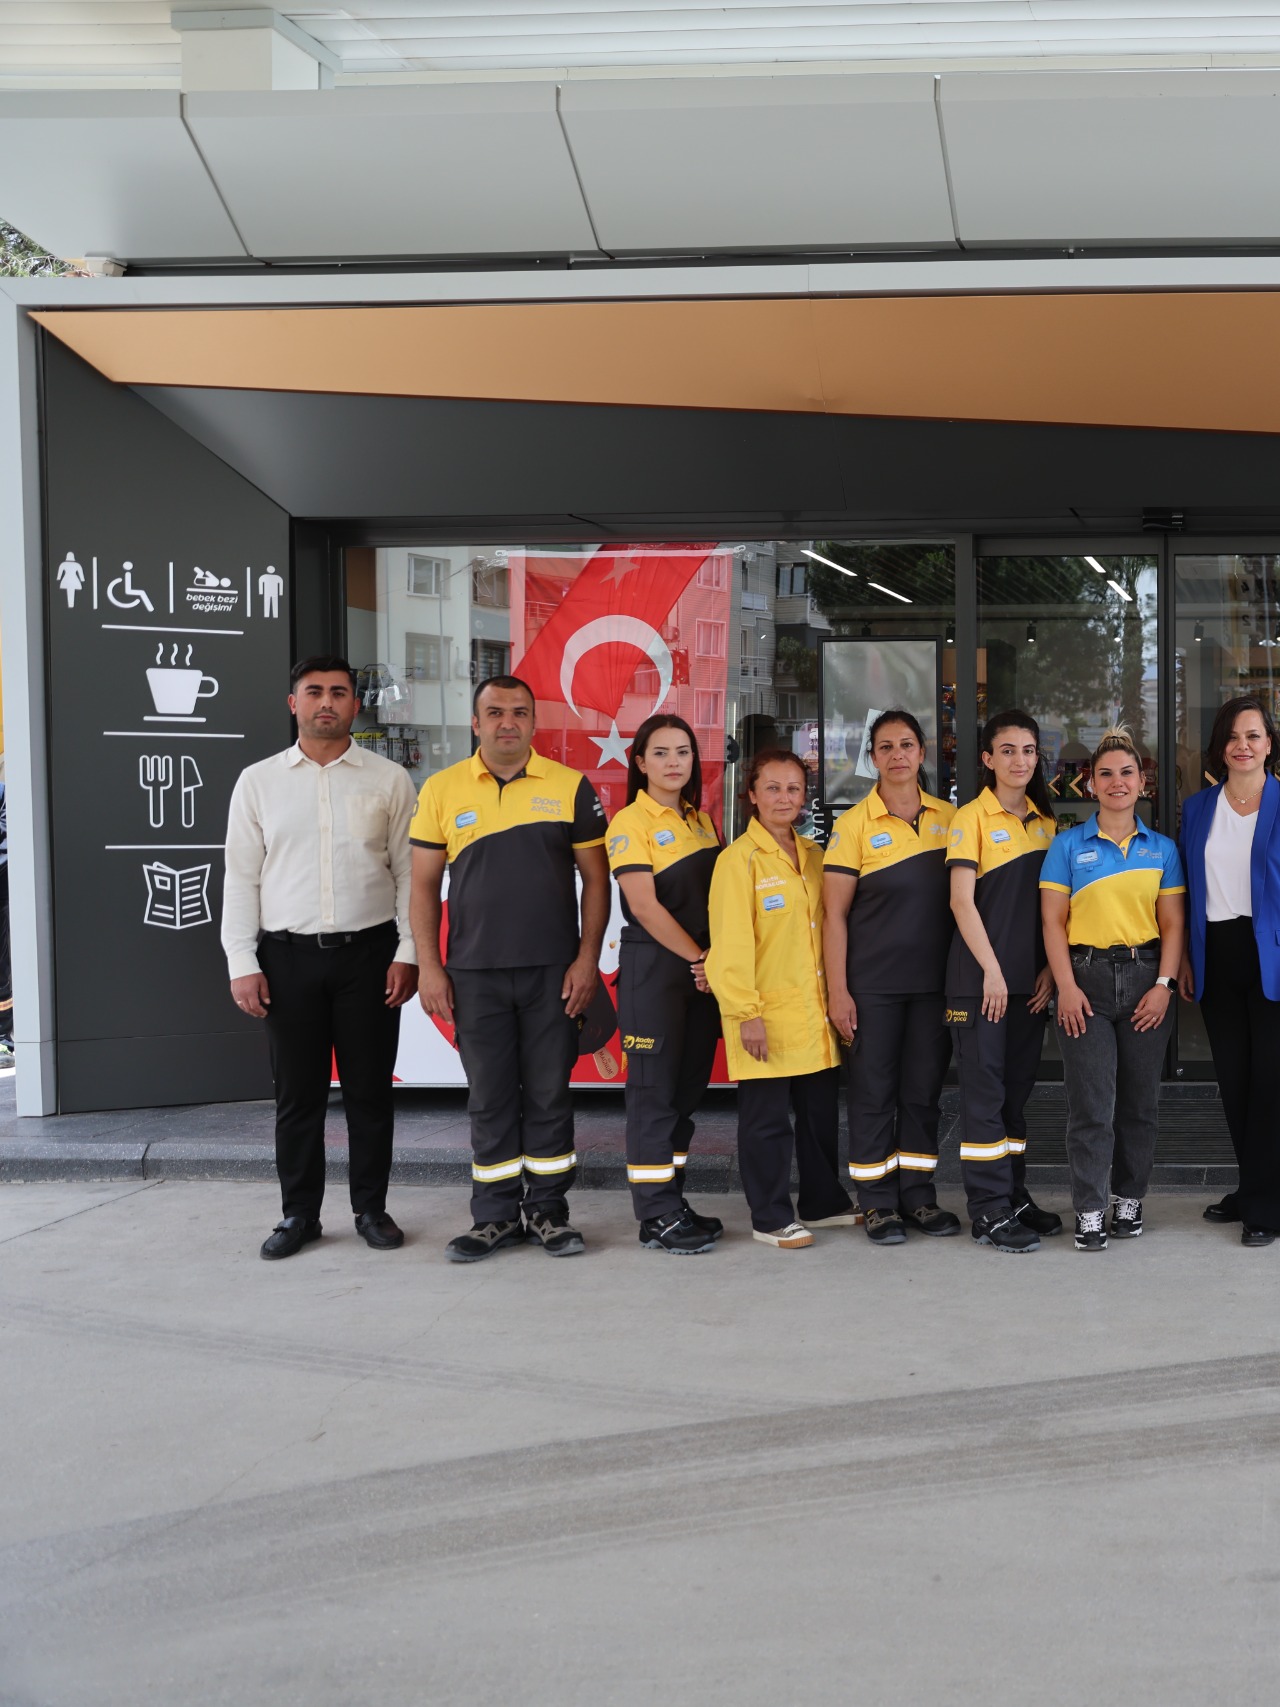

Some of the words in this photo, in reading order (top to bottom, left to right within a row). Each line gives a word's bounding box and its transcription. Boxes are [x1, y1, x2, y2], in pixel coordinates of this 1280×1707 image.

[186, 593, 215, 602] bebek
[217, 595, 238, 603] bezi
[192, 602, 233, 612] değişimi
